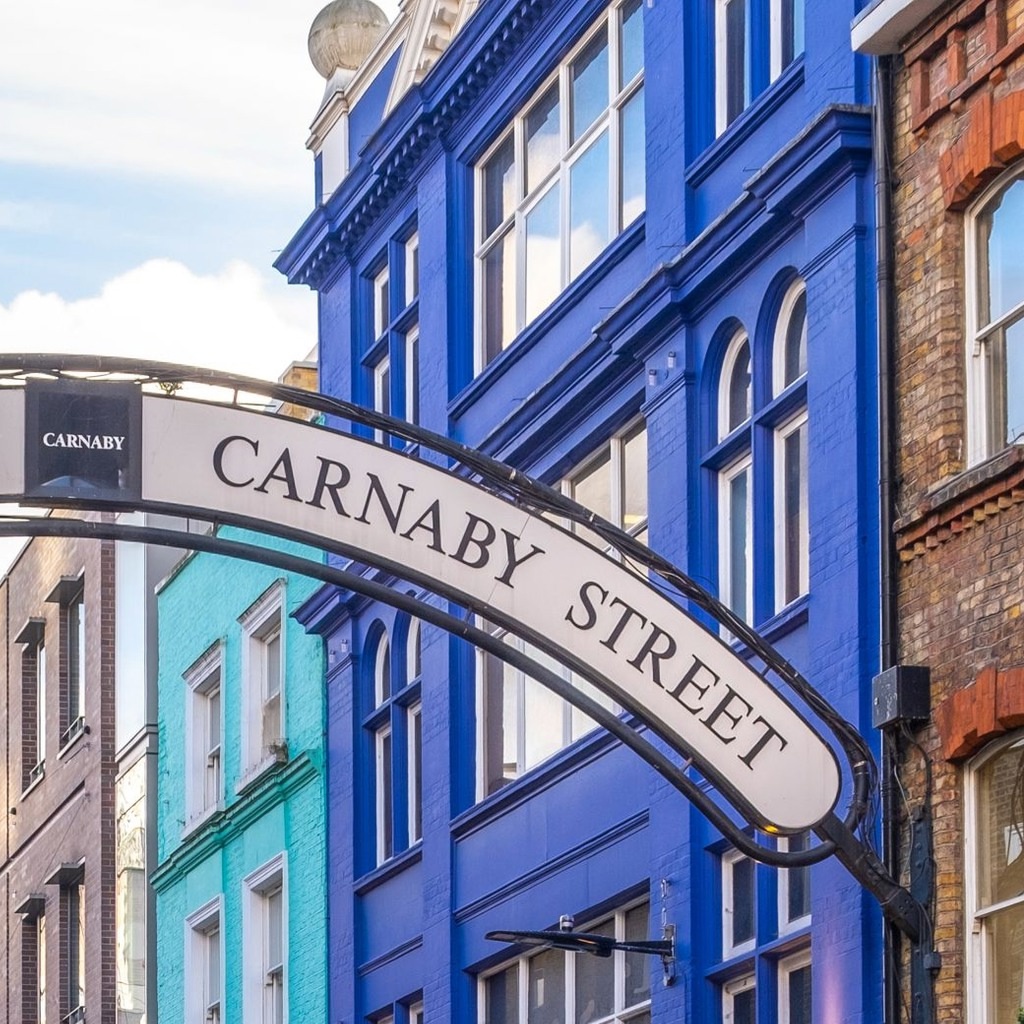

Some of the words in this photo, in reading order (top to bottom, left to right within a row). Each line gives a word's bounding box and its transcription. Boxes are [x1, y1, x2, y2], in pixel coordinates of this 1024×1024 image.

[43, 432, 125, 451] CARNABY
[212, 435, 546, 589] CARNABY
[564, 581, 788, 771] STREET
